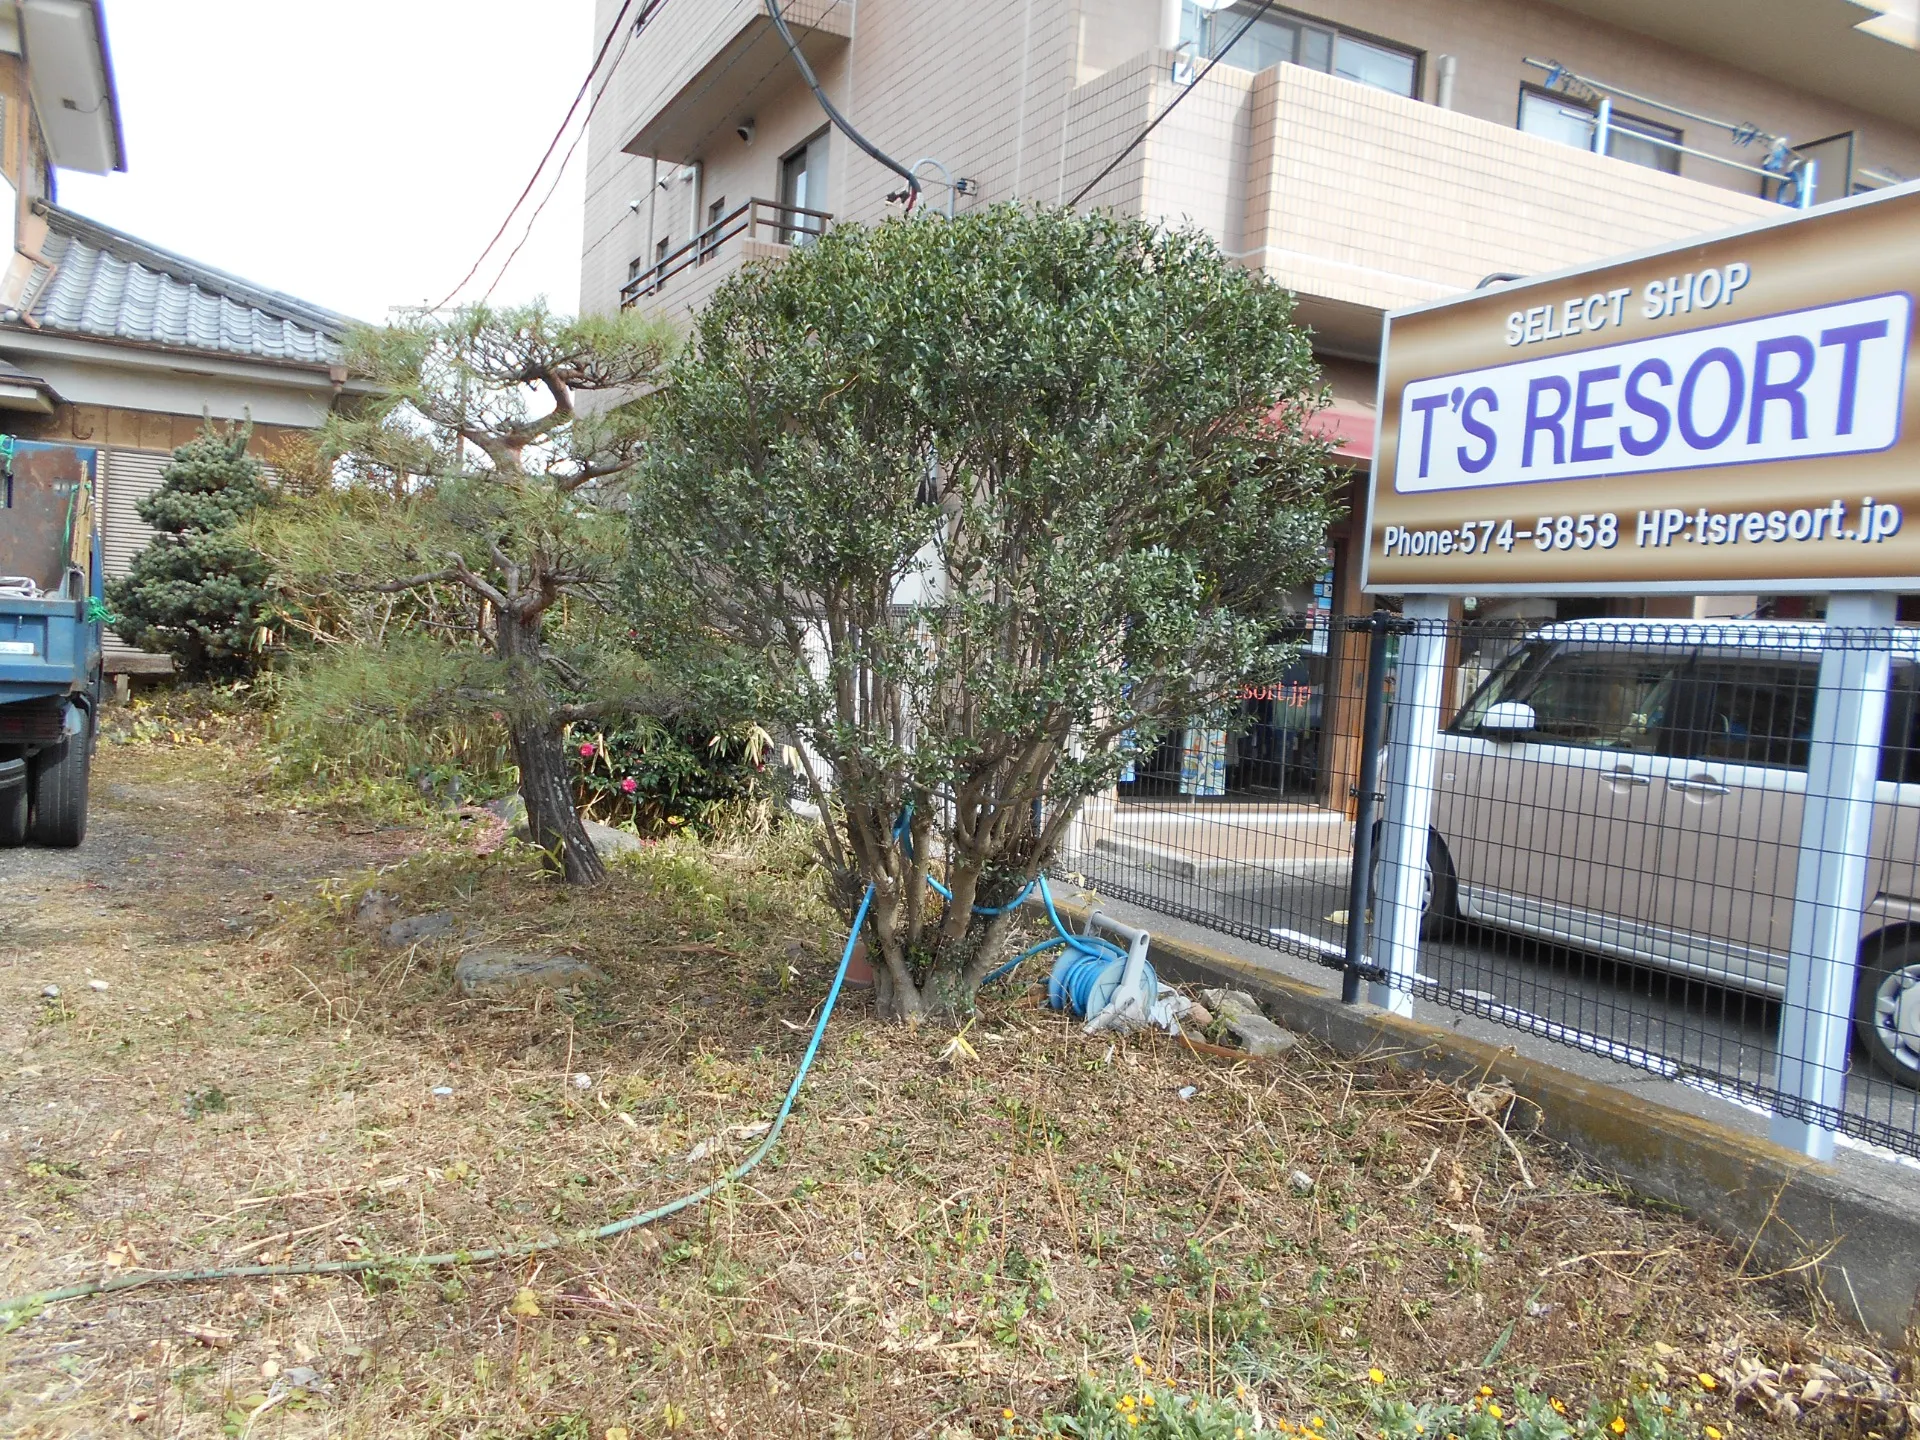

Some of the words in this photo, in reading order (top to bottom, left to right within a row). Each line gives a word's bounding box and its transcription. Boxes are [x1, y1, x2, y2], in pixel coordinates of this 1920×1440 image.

[1505, 288, 1632, 346] SELECT
[1641, 262, 1751, 320] SHOP
[1411, 386, 1499, 479] T'S
[1521, 319, 1889, 468] RESORT
[1384, 512, 1620, 558] Phone:574-5858
[1635, 496, 1902, 547] HP:tsresort.jp
